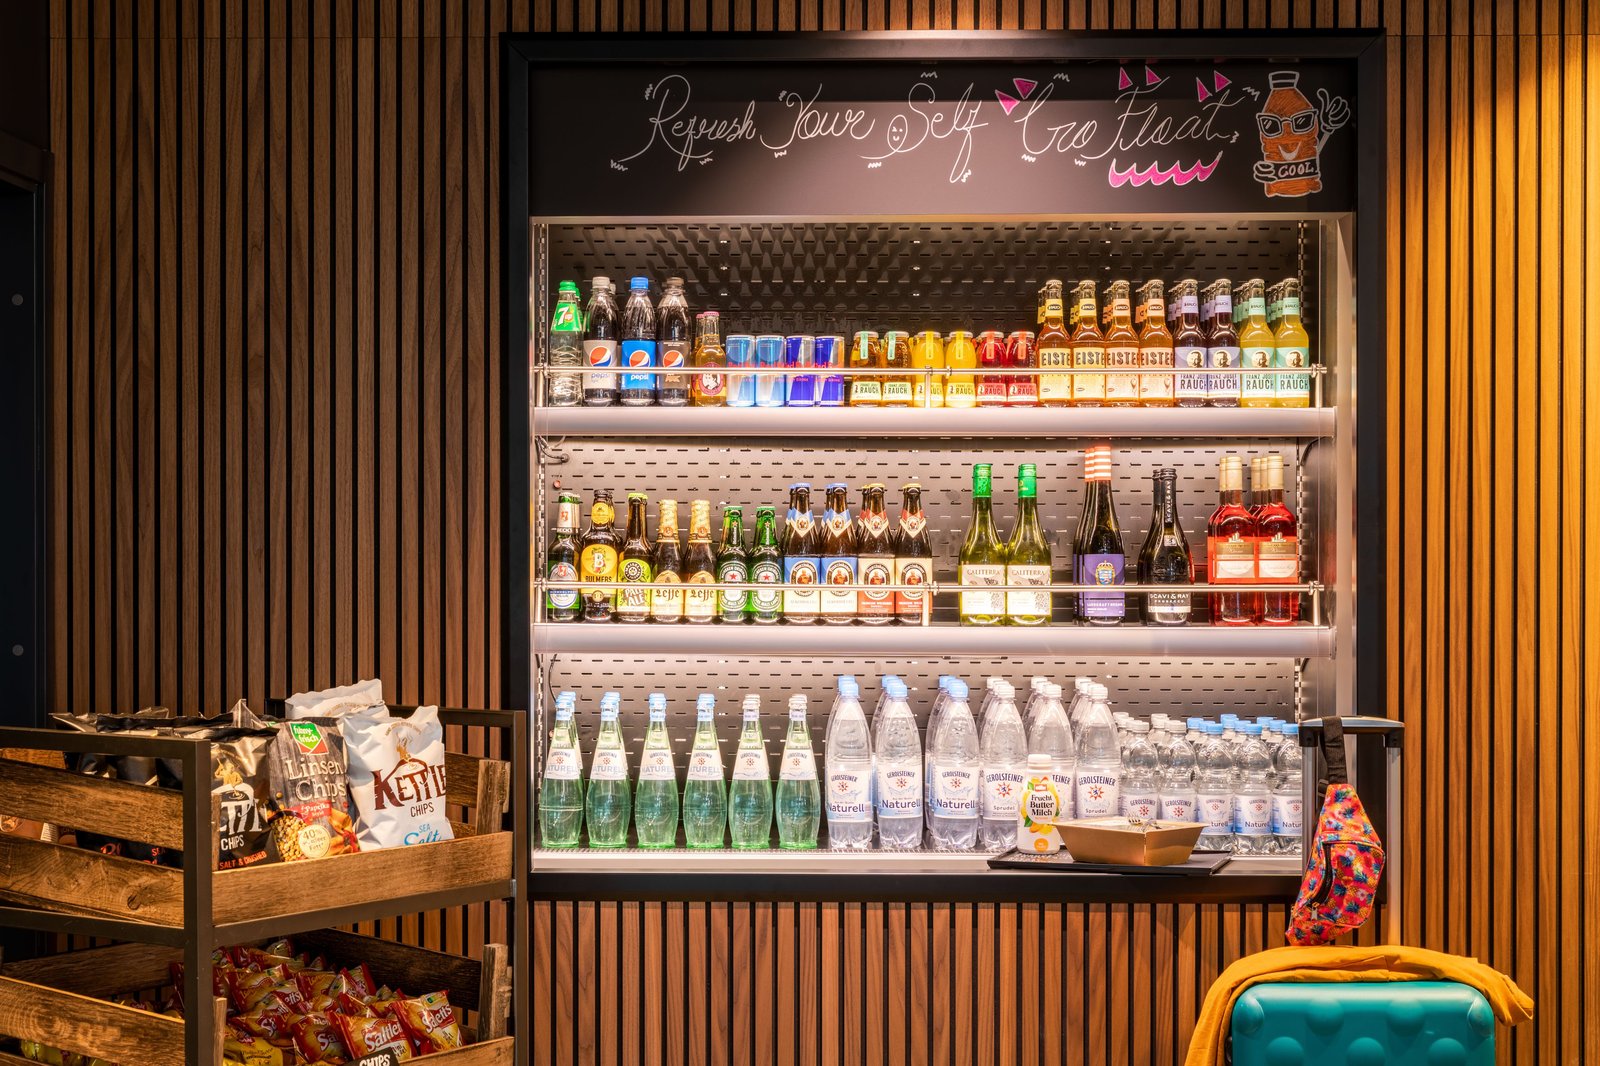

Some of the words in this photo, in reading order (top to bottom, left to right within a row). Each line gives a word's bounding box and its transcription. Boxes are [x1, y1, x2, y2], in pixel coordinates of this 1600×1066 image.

[618, 74, 756, 171] Refresh
[859, 82, 988, 183] Self
[1081, 76, 1247, 160] Float
[630, 372, 649, 381] pepsi
[1209, 379, 1238, 390] RAUCH
[1280, 379, 1309, 390] RAUCH
[285, 757, 344, 780] Linsen
[986, 773, 1024, 783] GEROLSTEINER
[1079, 775, 1116, 786] GEROLSTEINER
[295, 776, 347, 803] Chips
[370, 758, 447, 811] KETTLE
[1031, 794, 1053, 802] Frucht
[882, 799, 921, 809] Naturell
[936, 799, 976, 809] Naturell
[1030, 801, 1055, 809] Butter
[410, 802, 435, 818] CHIPS
[1031, 808, 1053, 817] Milch
[419, 824, 431, 833] SEA
[220, 834, 245, 851] CHIPS
[219, 860, 237, 870] SALT
